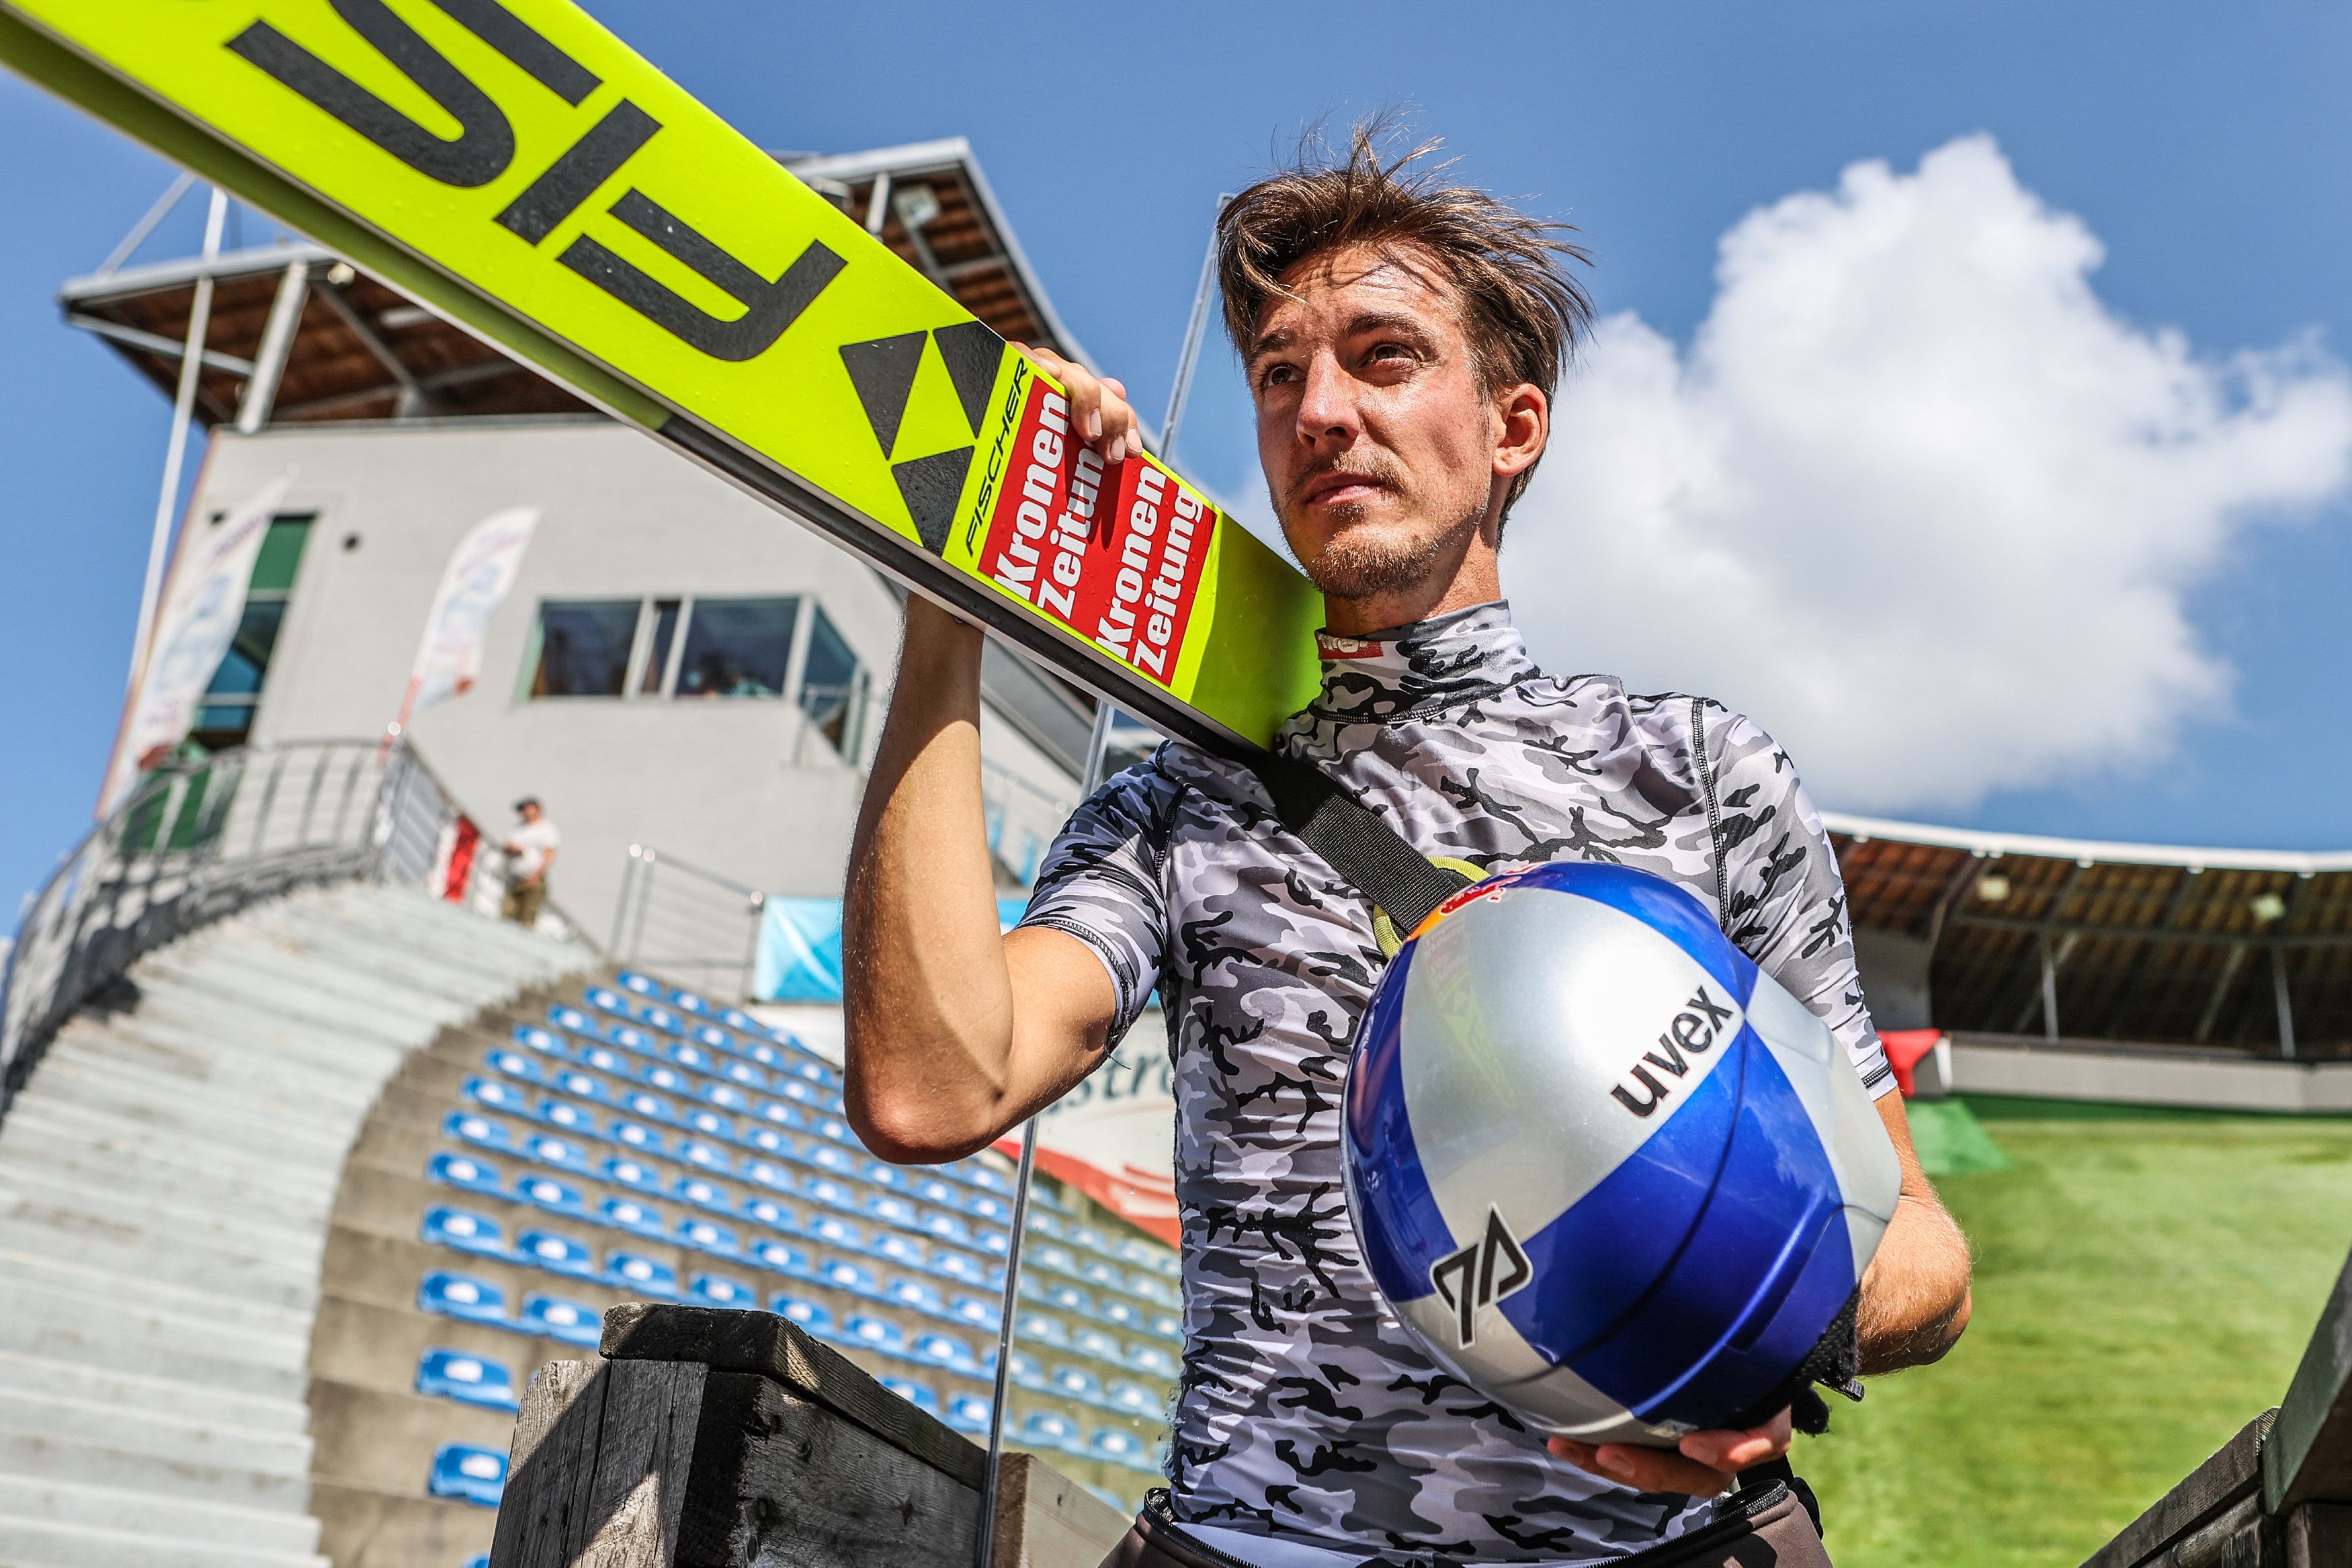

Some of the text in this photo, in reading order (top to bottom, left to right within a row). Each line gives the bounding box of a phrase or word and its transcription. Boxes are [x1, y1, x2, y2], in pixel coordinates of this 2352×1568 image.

[966, 359, 1027, 557] FISCHER
[994, 391, 1071, 601] Kronen
[1037, 441, 1104, 620] Zeitun
[1095, 466, 1166, 660] Kronen
[1133, 485, 1204, 677] Zeitung
[1611, 986, 1733, 1117] uvex
